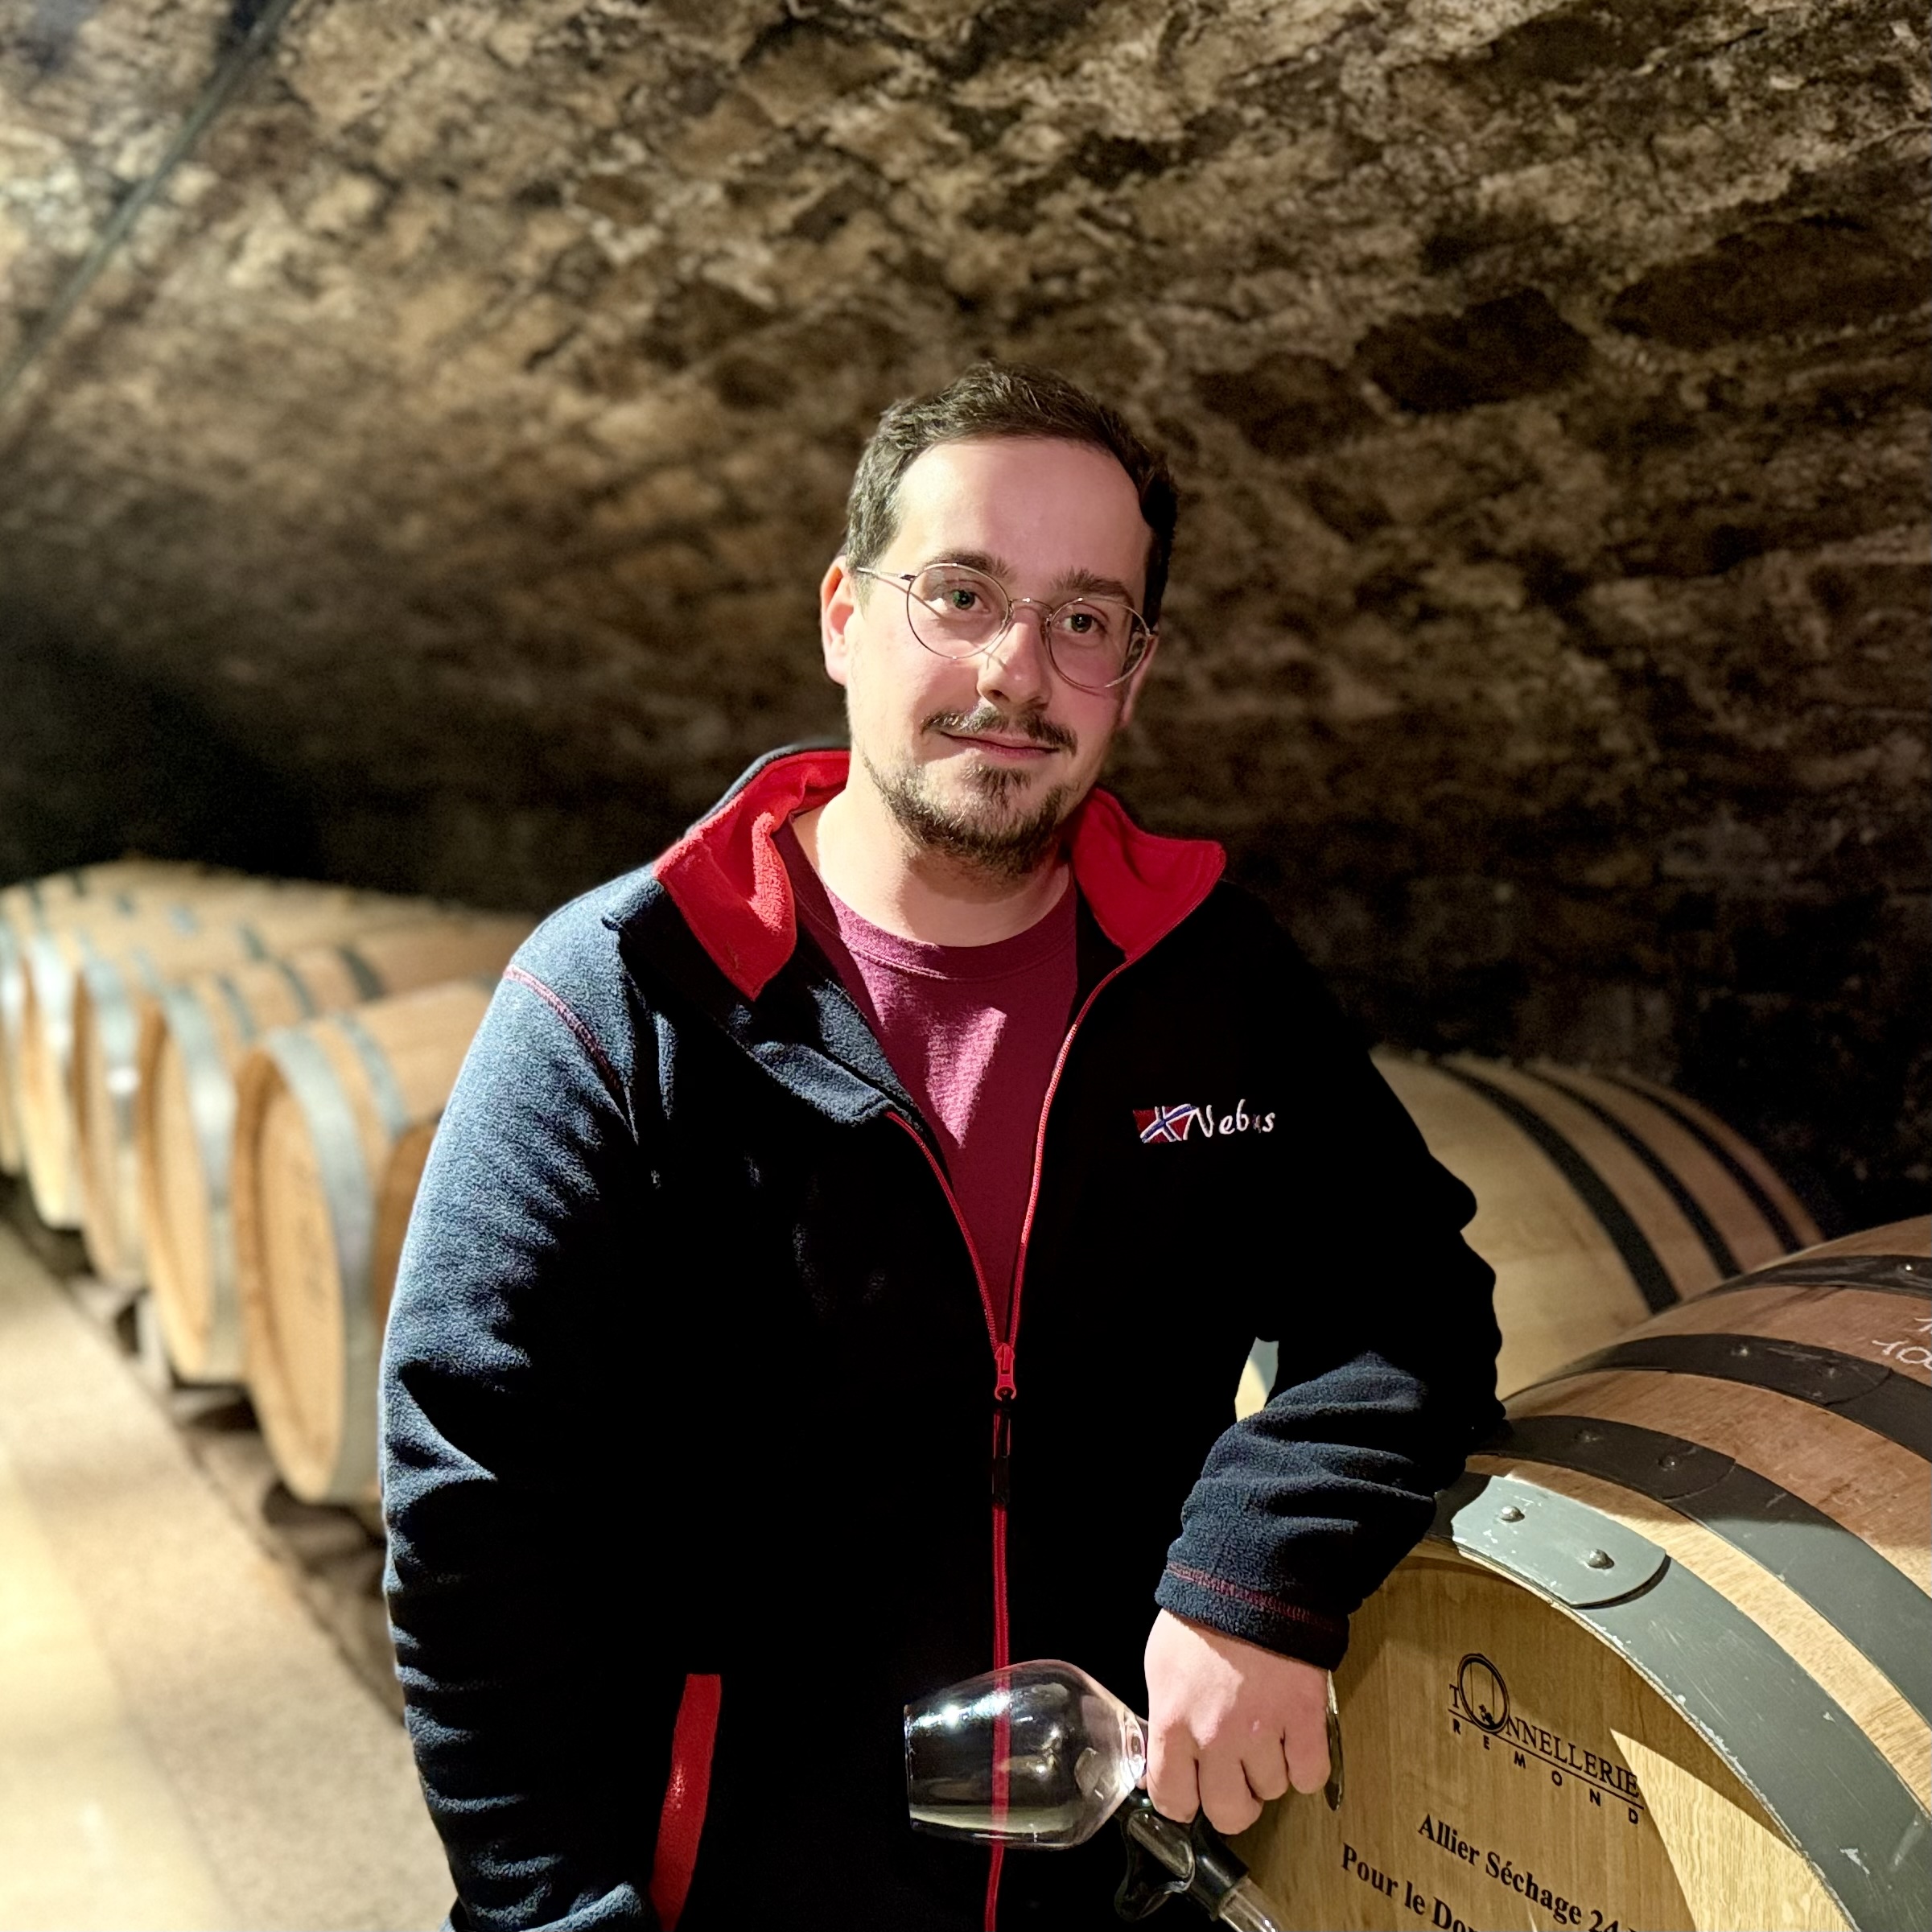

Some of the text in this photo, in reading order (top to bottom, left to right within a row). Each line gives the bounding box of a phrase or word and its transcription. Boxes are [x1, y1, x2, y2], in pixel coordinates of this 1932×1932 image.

[1449, 1653, 1639, 1799] TONNELLERIE
[1452, 1718, 1639, 1825] REMOND
[1341, 1842, 1399, 1898] Pour
[1404, 1880, 1426, 1916] le
[1417, 1813, 1480, 1866] Allier
[1485, 1852, 1582, 1926] Séchage
